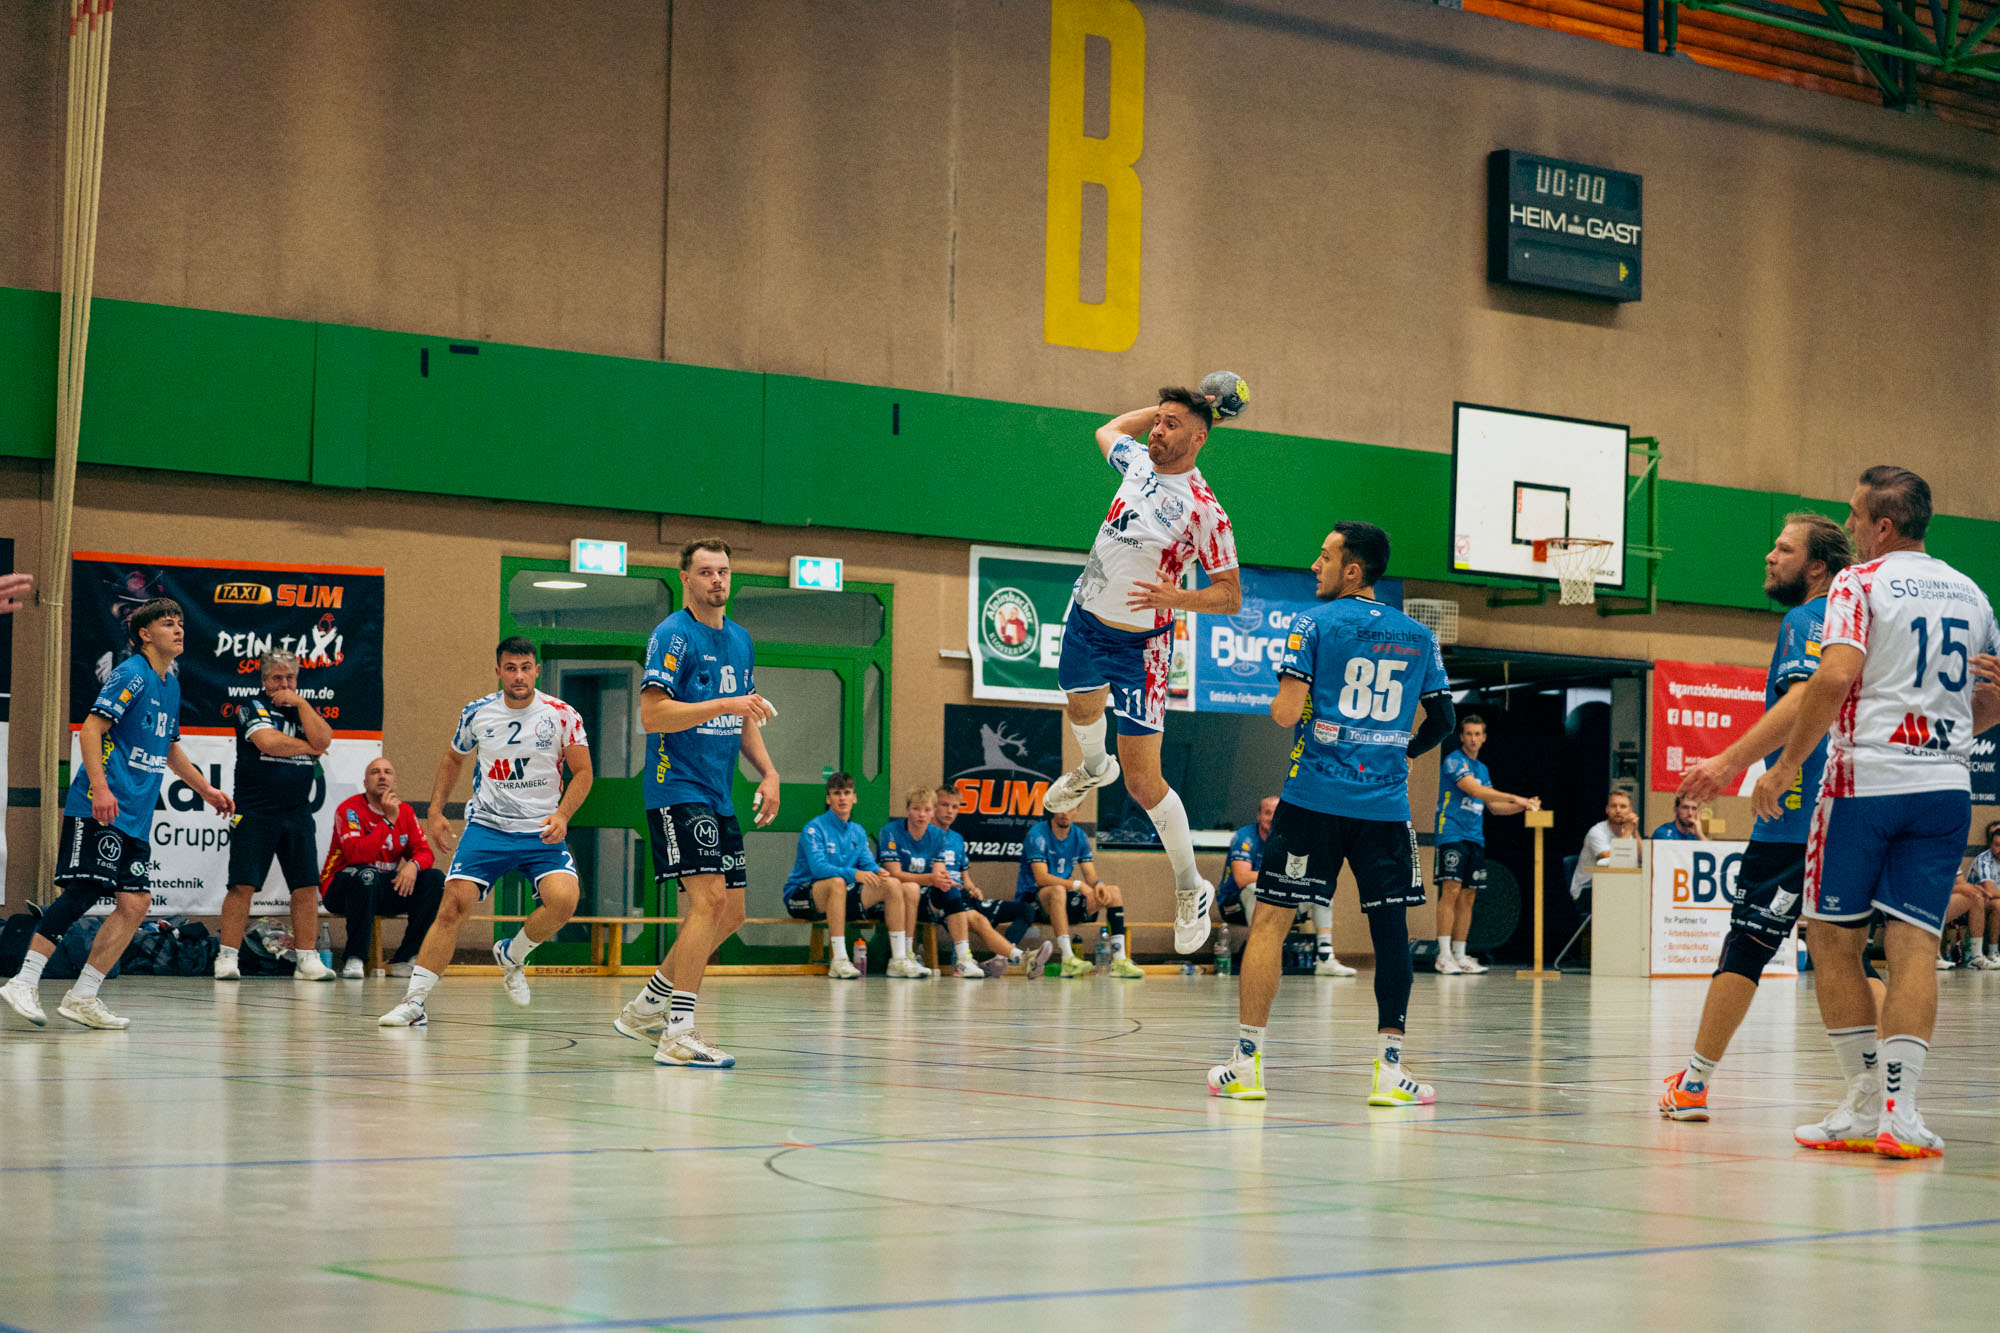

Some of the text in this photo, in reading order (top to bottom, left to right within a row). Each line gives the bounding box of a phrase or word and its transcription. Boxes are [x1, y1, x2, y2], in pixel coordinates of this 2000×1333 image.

[1044, 0, 1145, 352] B
[1510, 203, 1641, 246] HEIM GAST
[223, 584, 344, 609] TAXI SUM
[1890, 578, 1919, 598] SG
[1919, 579, 1977, 596] DUNNINGEN
[1919, 590, 1978, 607] SCHRAMBERG
[1296, 615, 1313, 633] TAXI
[214, 624, 344, 664] DEIN TAXI
[1911, 616, 1970, 693] 15
[1338, 656, 1409, 722] 85
[1122, 687, 1142, 716] 11
[507, 721, 522, 745] 2
[1316, 722, 1338, 732] BOSCH
[1349, 730, 1371, 742] Toni
[495, 778, 548, 790] SCHRAMBERG
[954, 778, 1049, 816] SUM
[153, 821, 231, 852] Grupp
[96, 858, 118, 872] Tadic
[561, 851, 577, 872] 2
